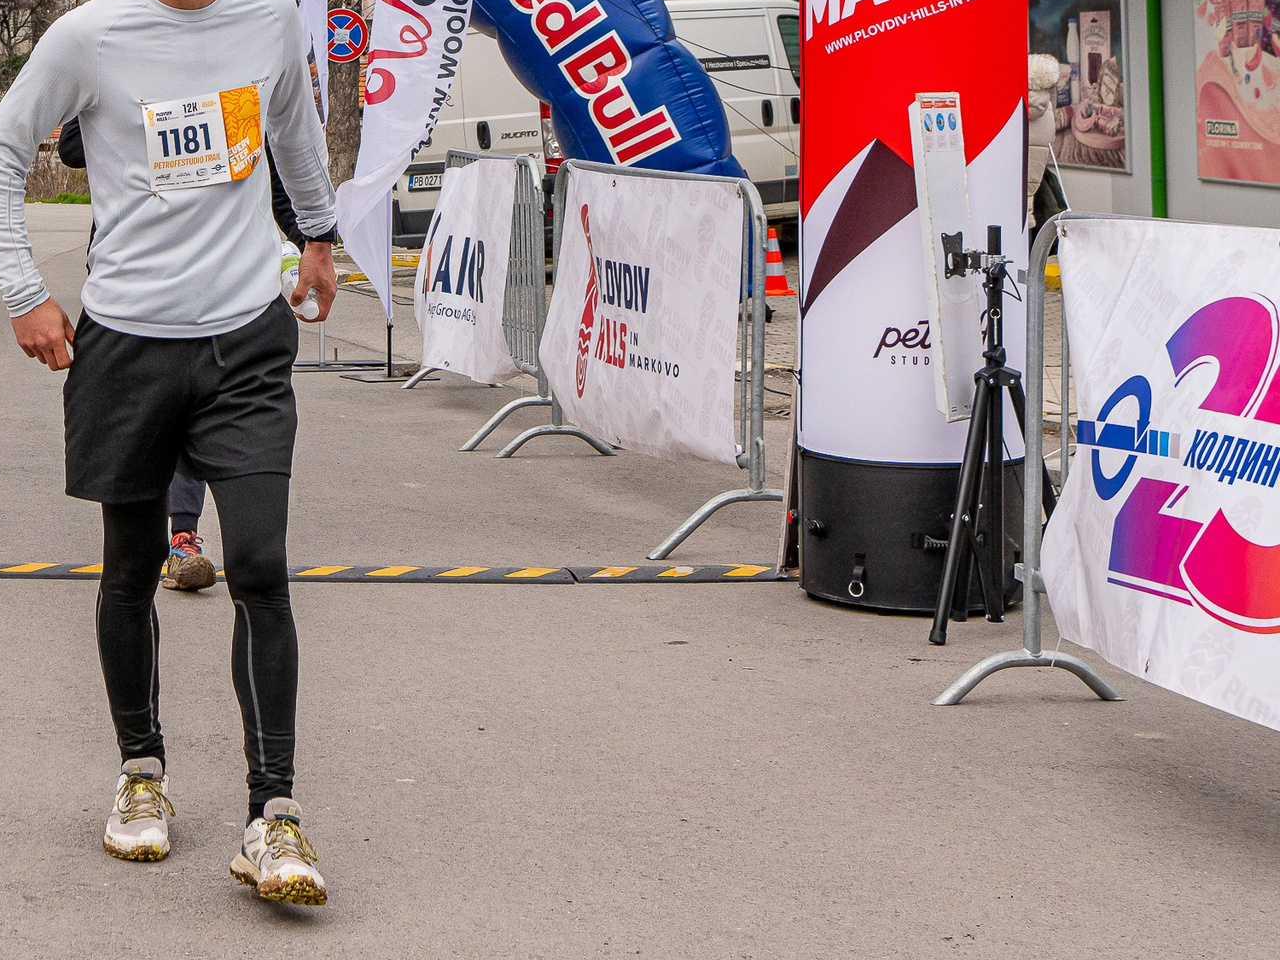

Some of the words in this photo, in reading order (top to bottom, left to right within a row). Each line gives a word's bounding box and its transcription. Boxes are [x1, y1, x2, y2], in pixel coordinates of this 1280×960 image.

[563, 35, 677, 165] Bull
[182, 101, 198, 114] 12K
[157, 122, 212, 158] 1181
[501, 130, 538, 139] DUCATO
[205, 152, 222, 163] TRAIL
[630, 331, 639, 346] IN
[629, 353, 680, 378] MARKOVO
[890, 355, 930, 366] STUD
